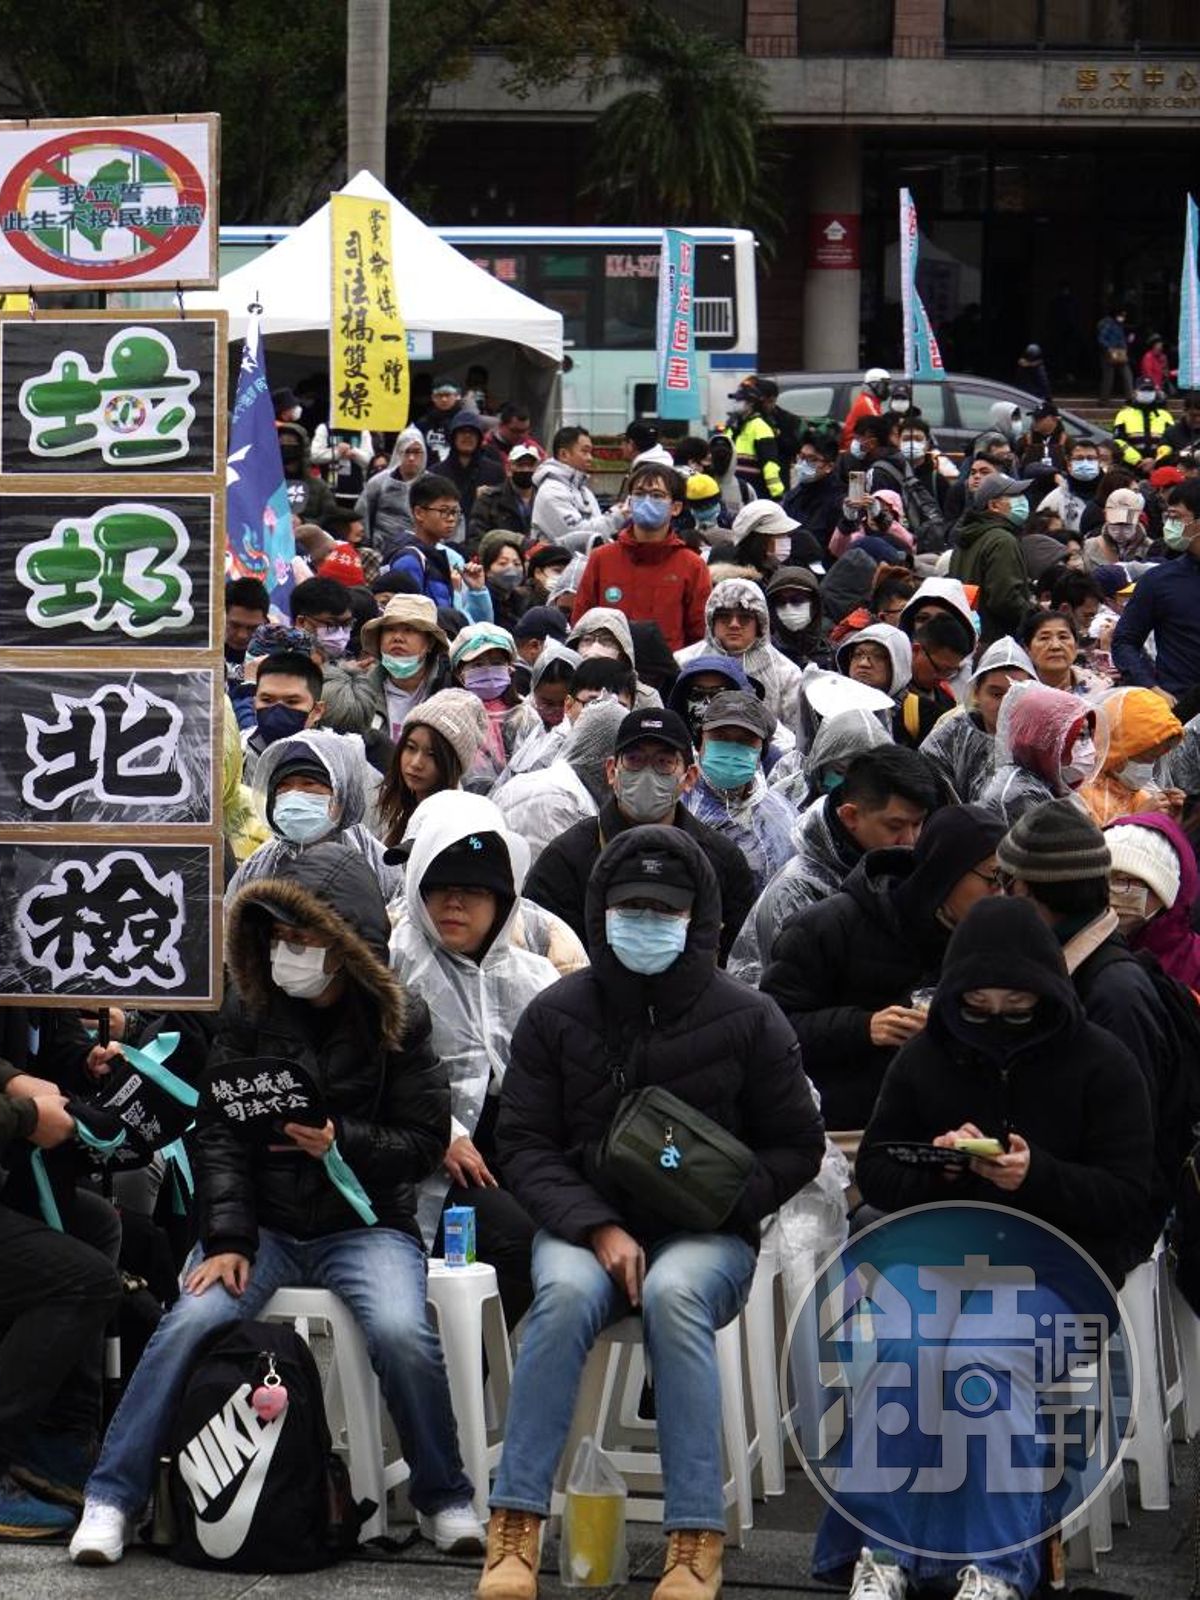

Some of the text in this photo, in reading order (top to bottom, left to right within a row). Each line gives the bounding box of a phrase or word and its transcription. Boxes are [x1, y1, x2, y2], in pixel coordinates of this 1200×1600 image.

[59, 184, 144, 205] 我立誓
[3, 206, 202, 232] 此生不投民進黨
[211, 1070, 302, 1102] 綠色威權
[223, 1093, 309, 1121] 司法不公
[178, 1383, 261, 1515] NIKE
